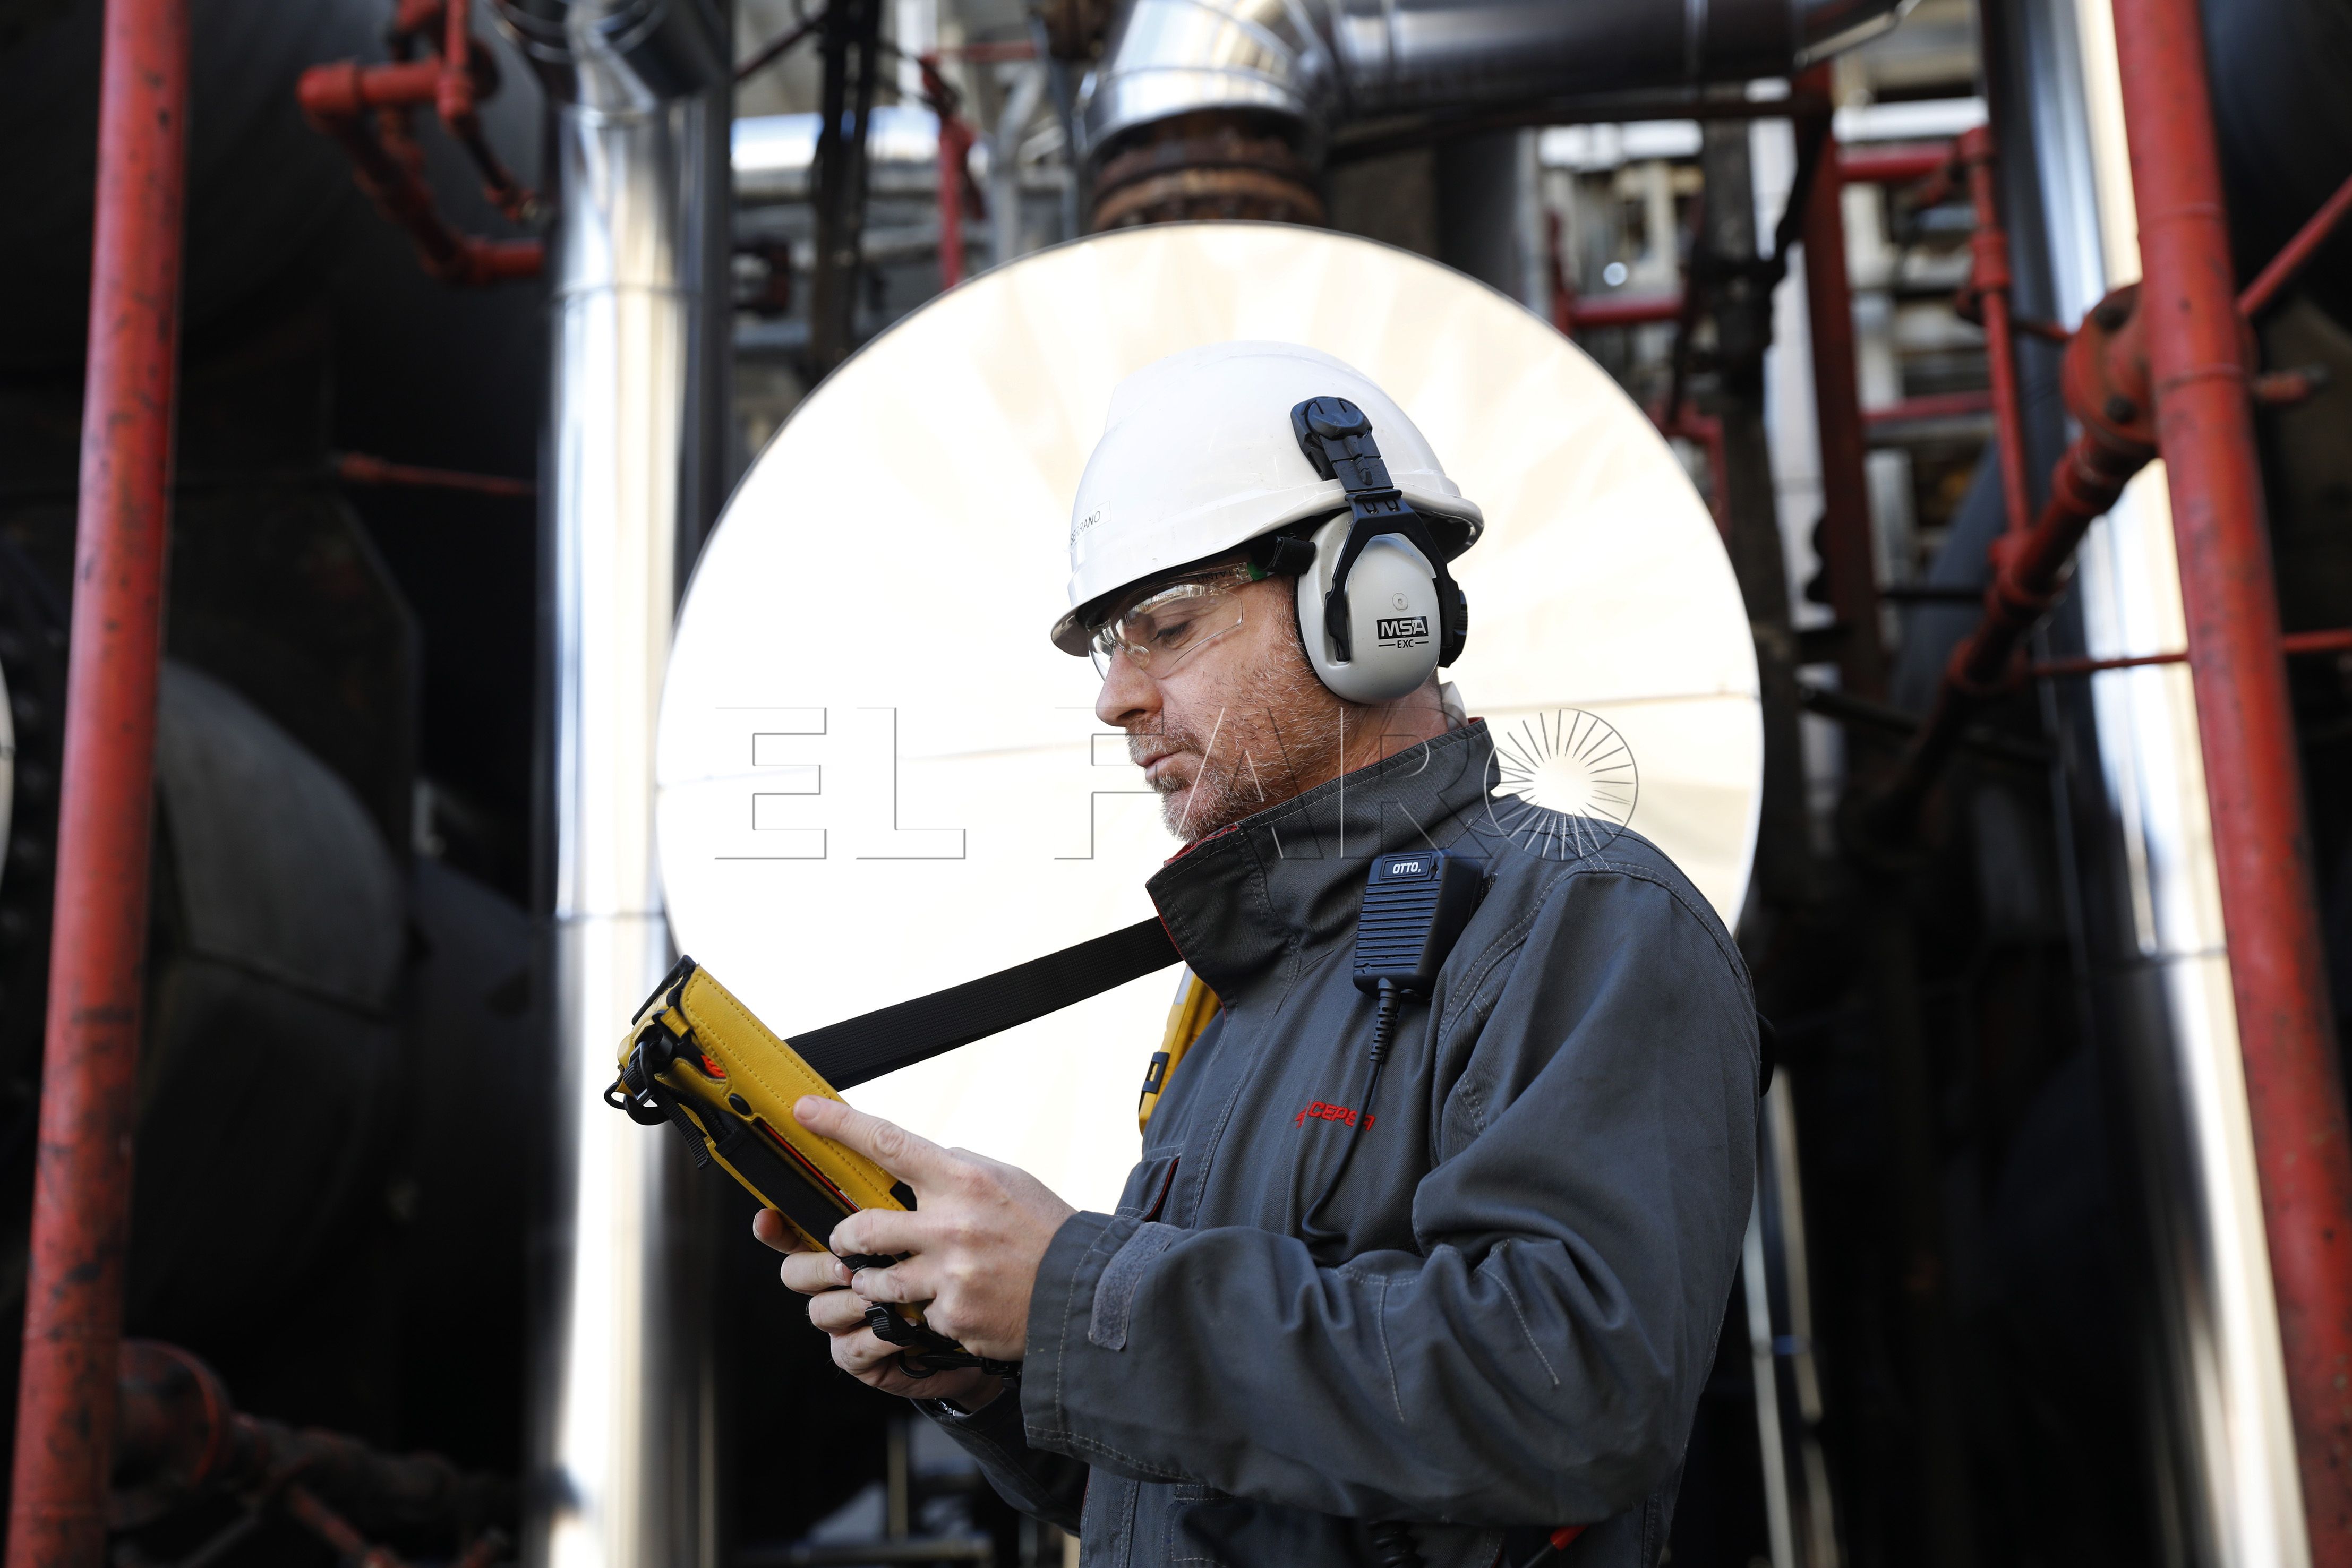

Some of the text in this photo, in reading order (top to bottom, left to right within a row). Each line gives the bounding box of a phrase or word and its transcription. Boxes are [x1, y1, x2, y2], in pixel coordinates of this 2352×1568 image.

[1196, 568, 1240, 584] UNIVET
[1381, 619, 1427, 637] MSA
[1397, 639, 1414, 648] EXC
[861, 1154, 886, 1177] OBILE
